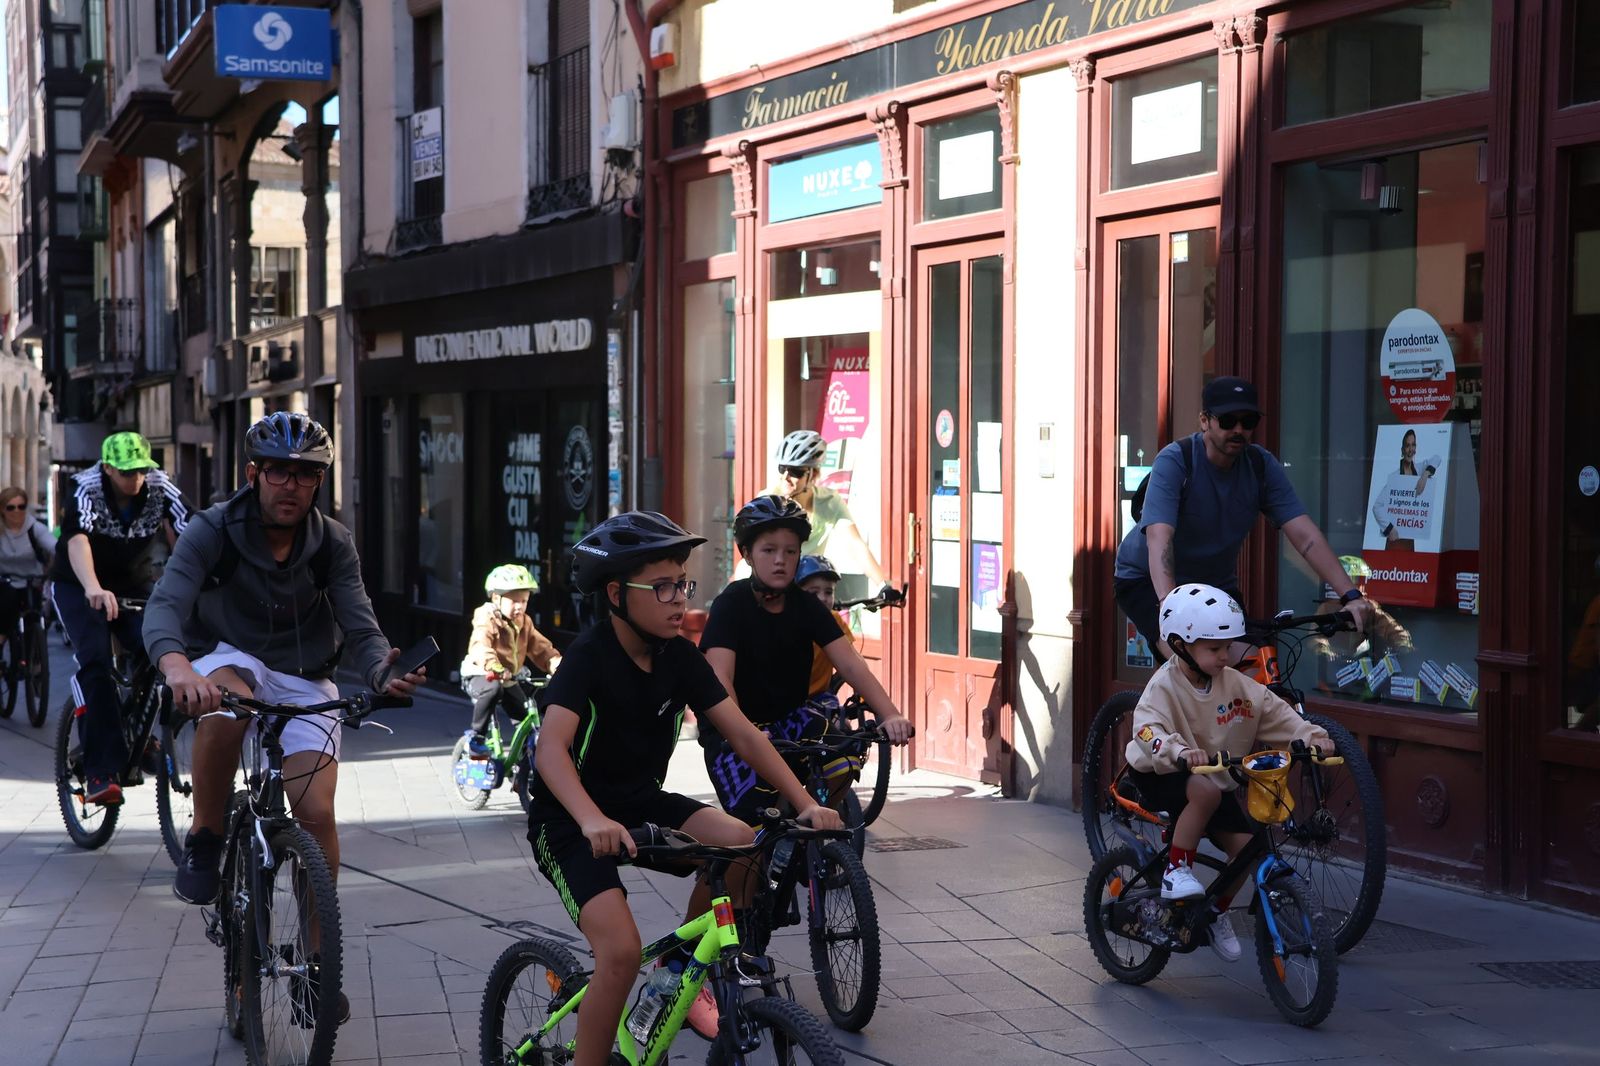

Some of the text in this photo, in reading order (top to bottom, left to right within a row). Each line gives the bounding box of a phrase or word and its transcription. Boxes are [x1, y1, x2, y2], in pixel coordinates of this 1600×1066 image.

[935, 2, 1070, 75] Yolanda
[225, 55, 324, 75] Samsonite
[741, 71, 849, 130] Farmacia
[415, 138, 441, 160] VENDE
[803, 165, 852, 193] NUXE
[415, 318, 592, 364] UNCONVENTIONAL WORLD
[1388, 333, 1440, 352] parodontax
[1393, 368, 1420, 376] parodontax
[1399, 387, 1412, 395] Para
[1427, 387, 1438, 396] que
[1423, 393, 1451, 403] inflamadas
[1407, 403, 1438, 413] enrojecidas.
[503, 465, 541, 495] GUSTA
[1390, 489, 1415, 498] REVIERTE
[1393, 499, 1412, 507] signos
[1420, 500, 1430, 508] los
[508, 498, 529, 527] CUI
[1387, 507, 1420, 517] PROBLEMAS
[515, 531, 540, 561] DAR
[1365, 567, 1429, 584] parodontax
[1216, 706, 1254, 726] MARVEL
[638, 979, 685, 1066] OCKRIDER
